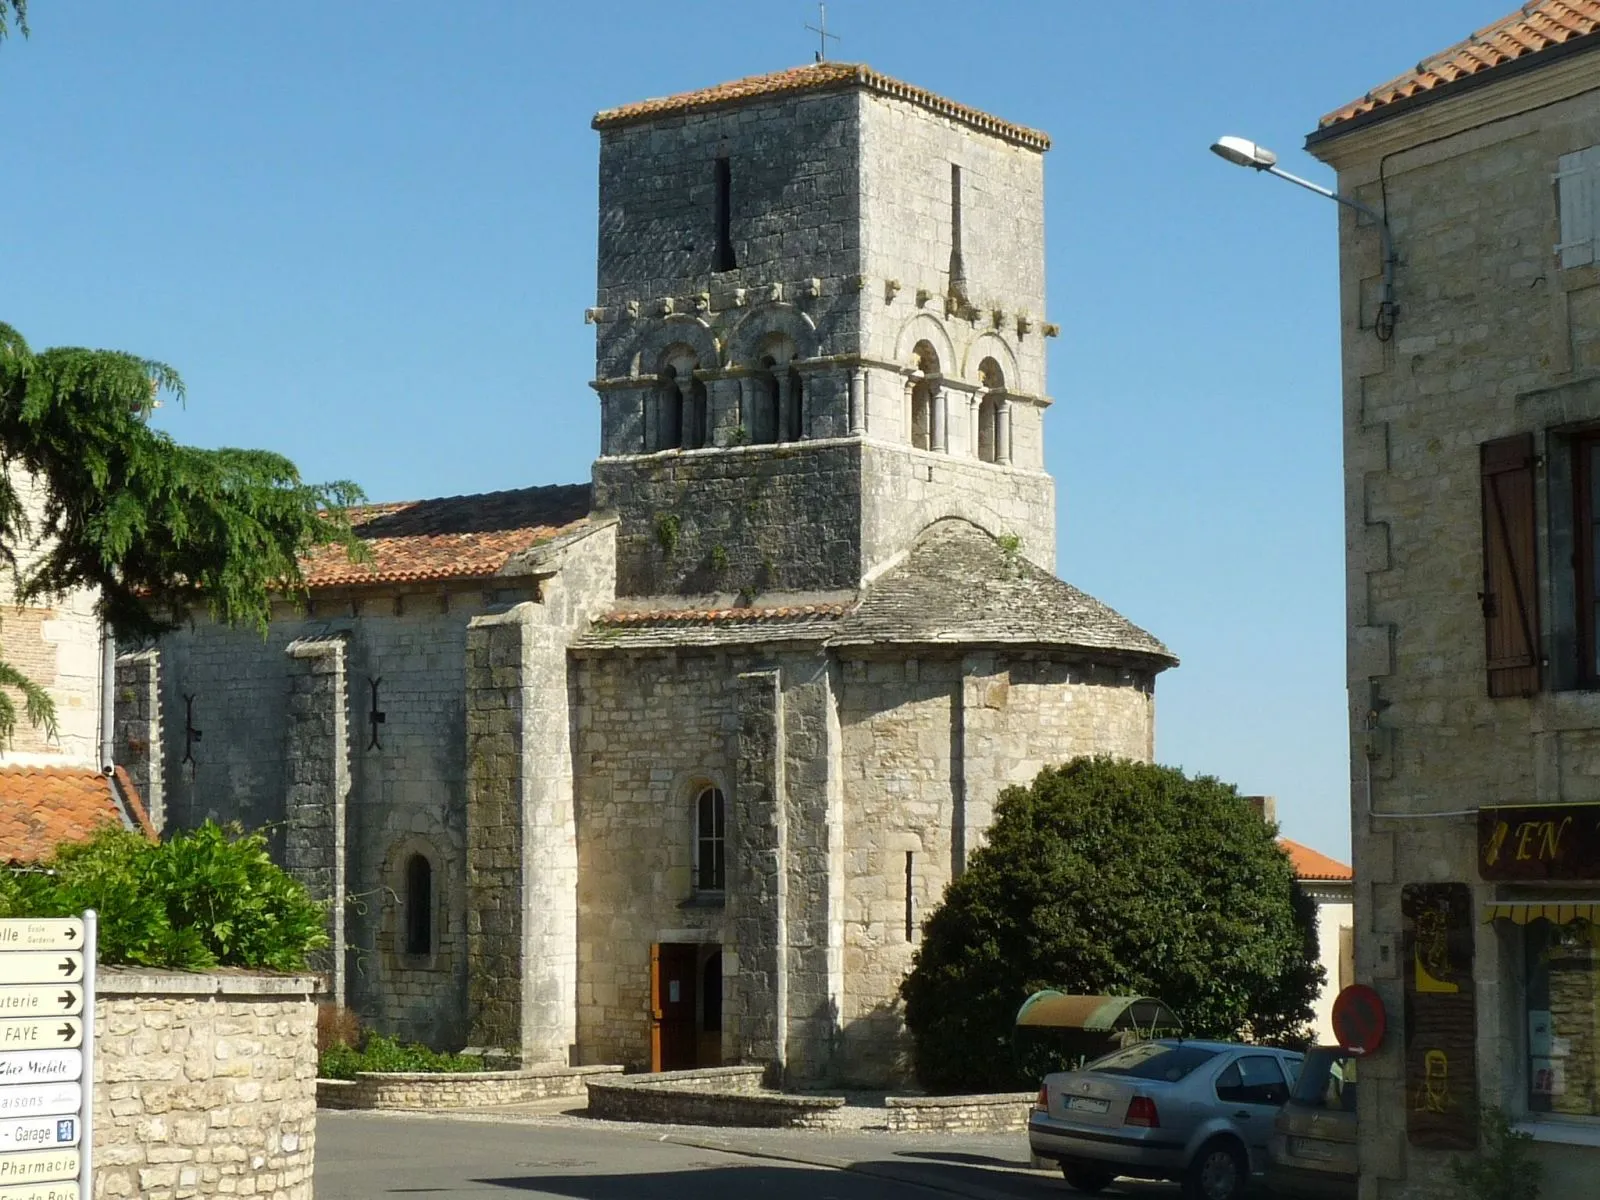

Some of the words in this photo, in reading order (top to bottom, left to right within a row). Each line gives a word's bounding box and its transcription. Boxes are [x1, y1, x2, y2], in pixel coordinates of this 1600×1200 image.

[0, 927, 19, 942] lle
[5, 1026, 38, 1041] FAYE
[15, 1126, 51, 1144] Garage
[0, 1156, 76, 1176] Pharmacie
